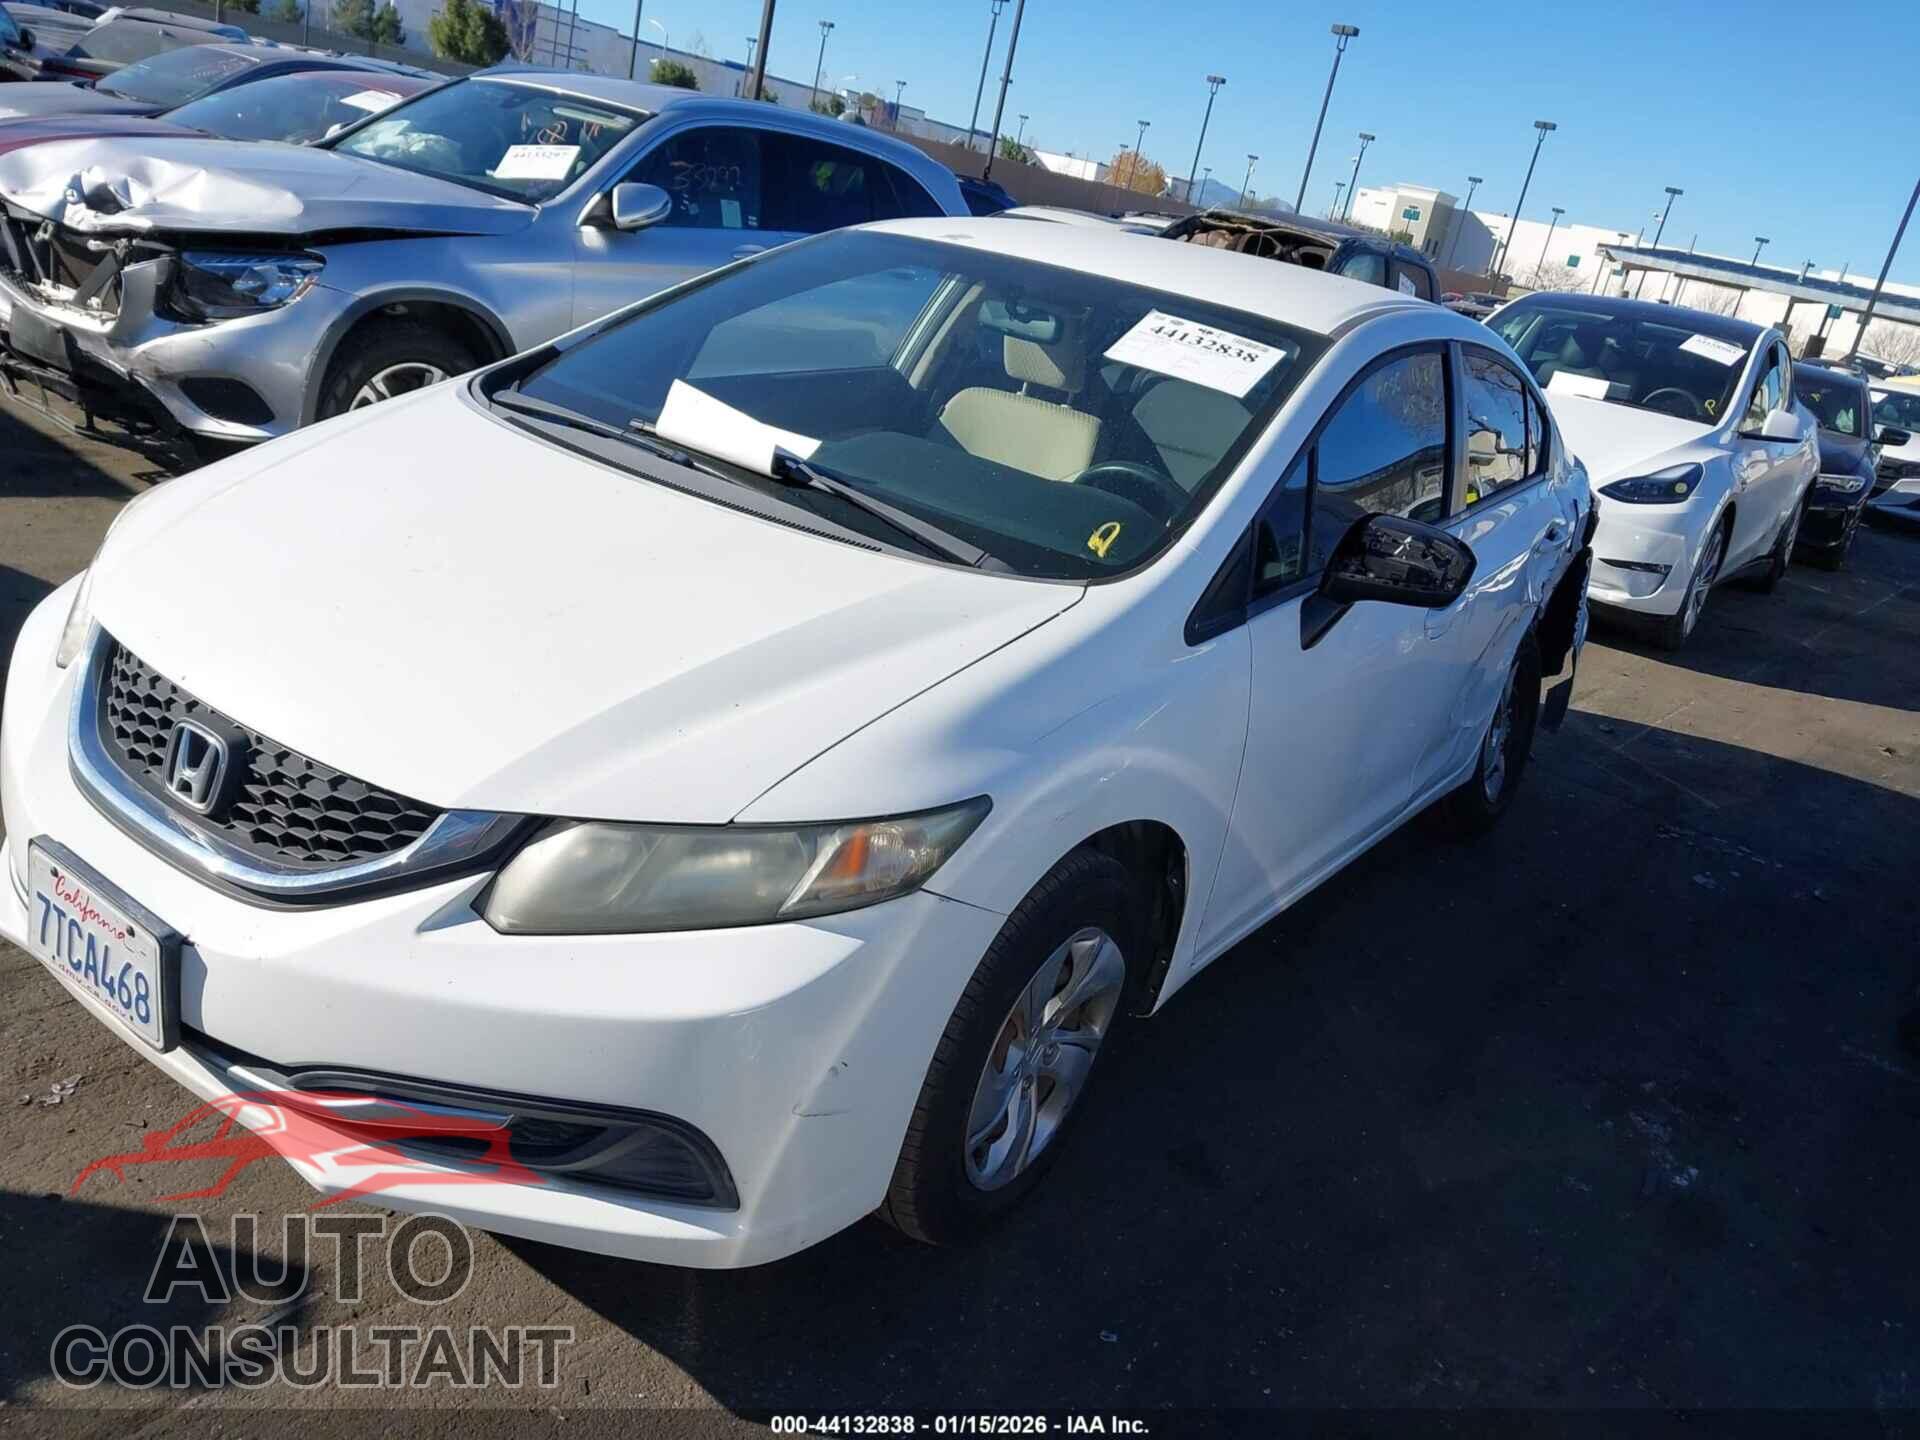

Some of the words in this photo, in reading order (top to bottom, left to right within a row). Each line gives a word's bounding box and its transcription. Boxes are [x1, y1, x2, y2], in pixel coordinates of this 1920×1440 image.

[1151, 325, 1259, 362] 44132838
[54, 875, 126, 941] California
[36, 891, 150, 1024] 7TCA468
